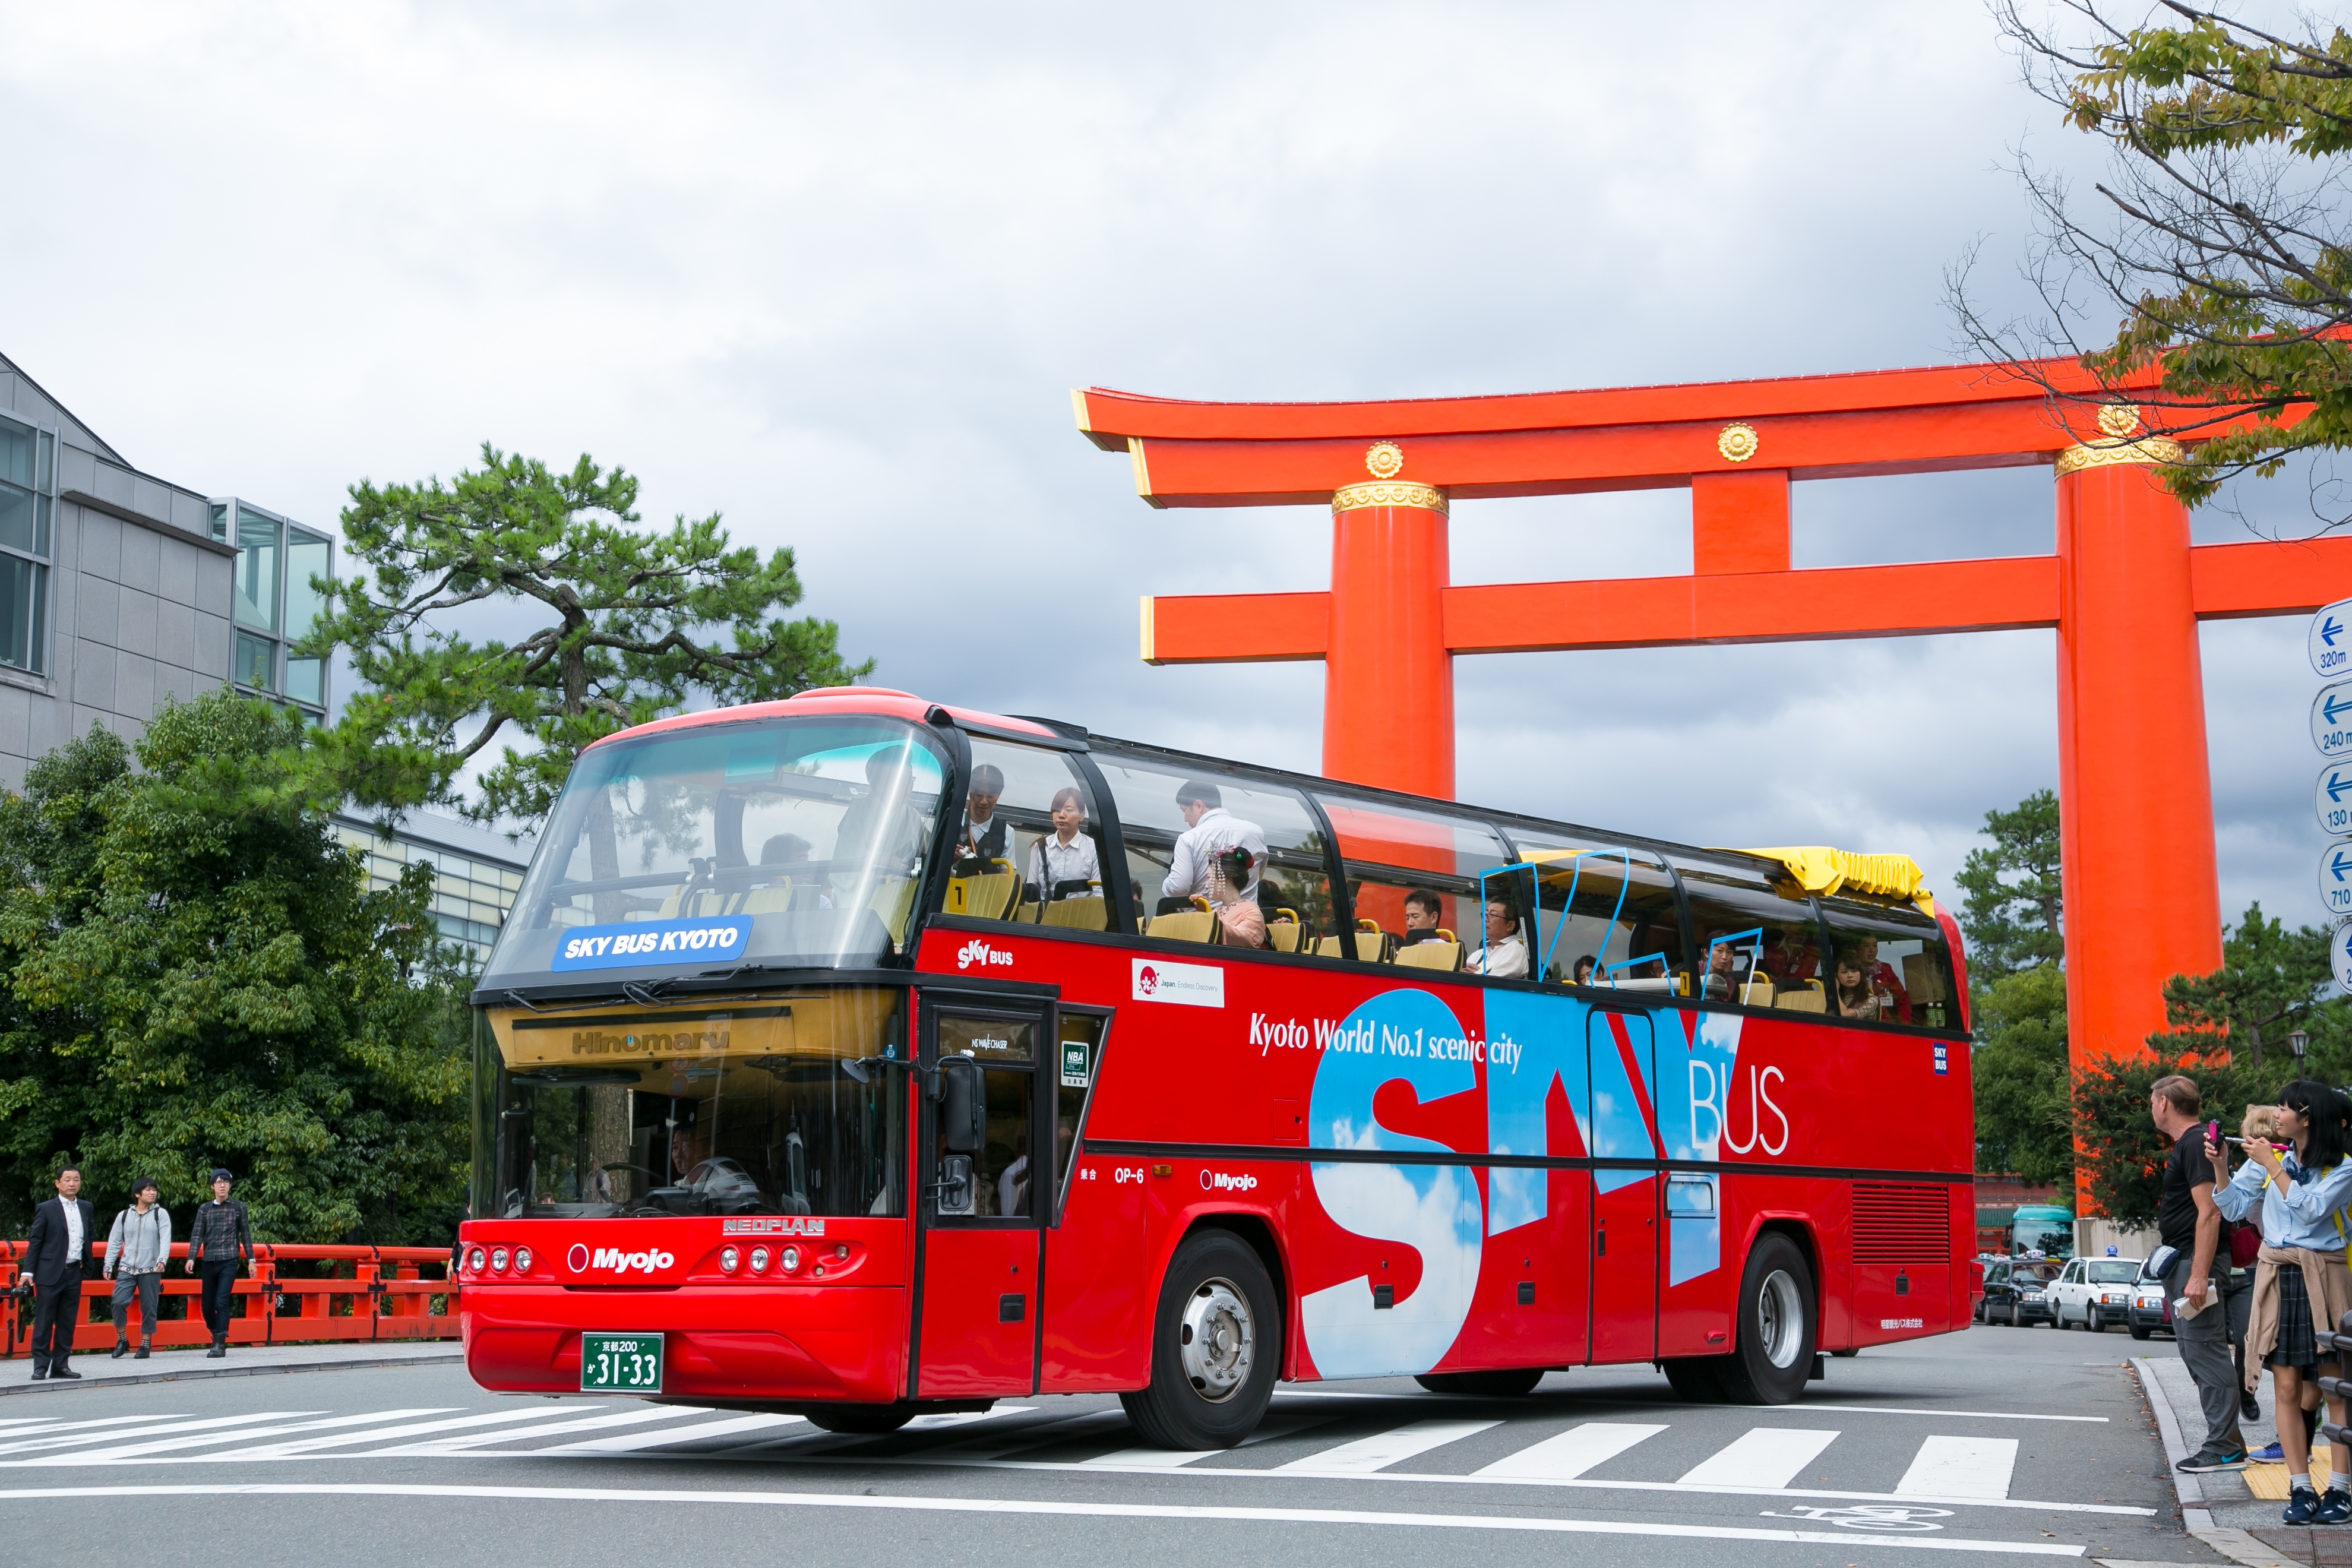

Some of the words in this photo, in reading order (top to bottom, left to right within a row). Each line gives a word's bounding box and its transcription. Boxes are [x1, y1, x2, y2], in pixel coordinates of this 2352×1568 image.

[2321, 650, 2346, 669] 320m
[2323, 731, 2344, 750] 240
[2328, 809, 2347, 827] 130
[954, 886, 962, 905] 1
[2331, 889, 2350, 906] 710
[565, 937, 613, 959] SKY
[611, 932, 659, 954] BUS
[659, 927, 738, 951] KYOTO
[957, 939, 990, 969] SKY
[990, 950, 1013, 966] BUS
[1161, 979, 1177, 988] Japan.
[1178, 981, 1195, 990] Endless
[1196, 983, 1218, 992] Discovery.
[572, 1032, 729, 1054] Hinomaru
[971, 1038, 978, 1048] NS
[990, 1039, 1007, 1049] CHASER
[1250, 1012, 1308, 1056] Kyoto
[1314, 1018, 1375, 1053] World
[1382, 1024, 1423, 1057] No.1
[1428, 1030, 1485, 1062] scenic
[1490, 1032, 1523, 1074] city
[1067, 1051, 1083, 1062] NBA
[1934, 1047, 1946, 1058] SKY
[1935, 1060, 1947, 1070] BUS
[1689, 1060, 1789, 1156] BUS
[1080, 1168, 1097, 1181] 乗合
[1115, 1168, 1144, 1184] OP-6
[1215, 1173, 1257, 1191] Myojo
[723, 1218, 825, 1236] NEOPLAN
[592, 1248, 675, 1273] Myojo
[587, 1364, 595, 1374] か
[597, 1354, 656, 1384] 31-33
